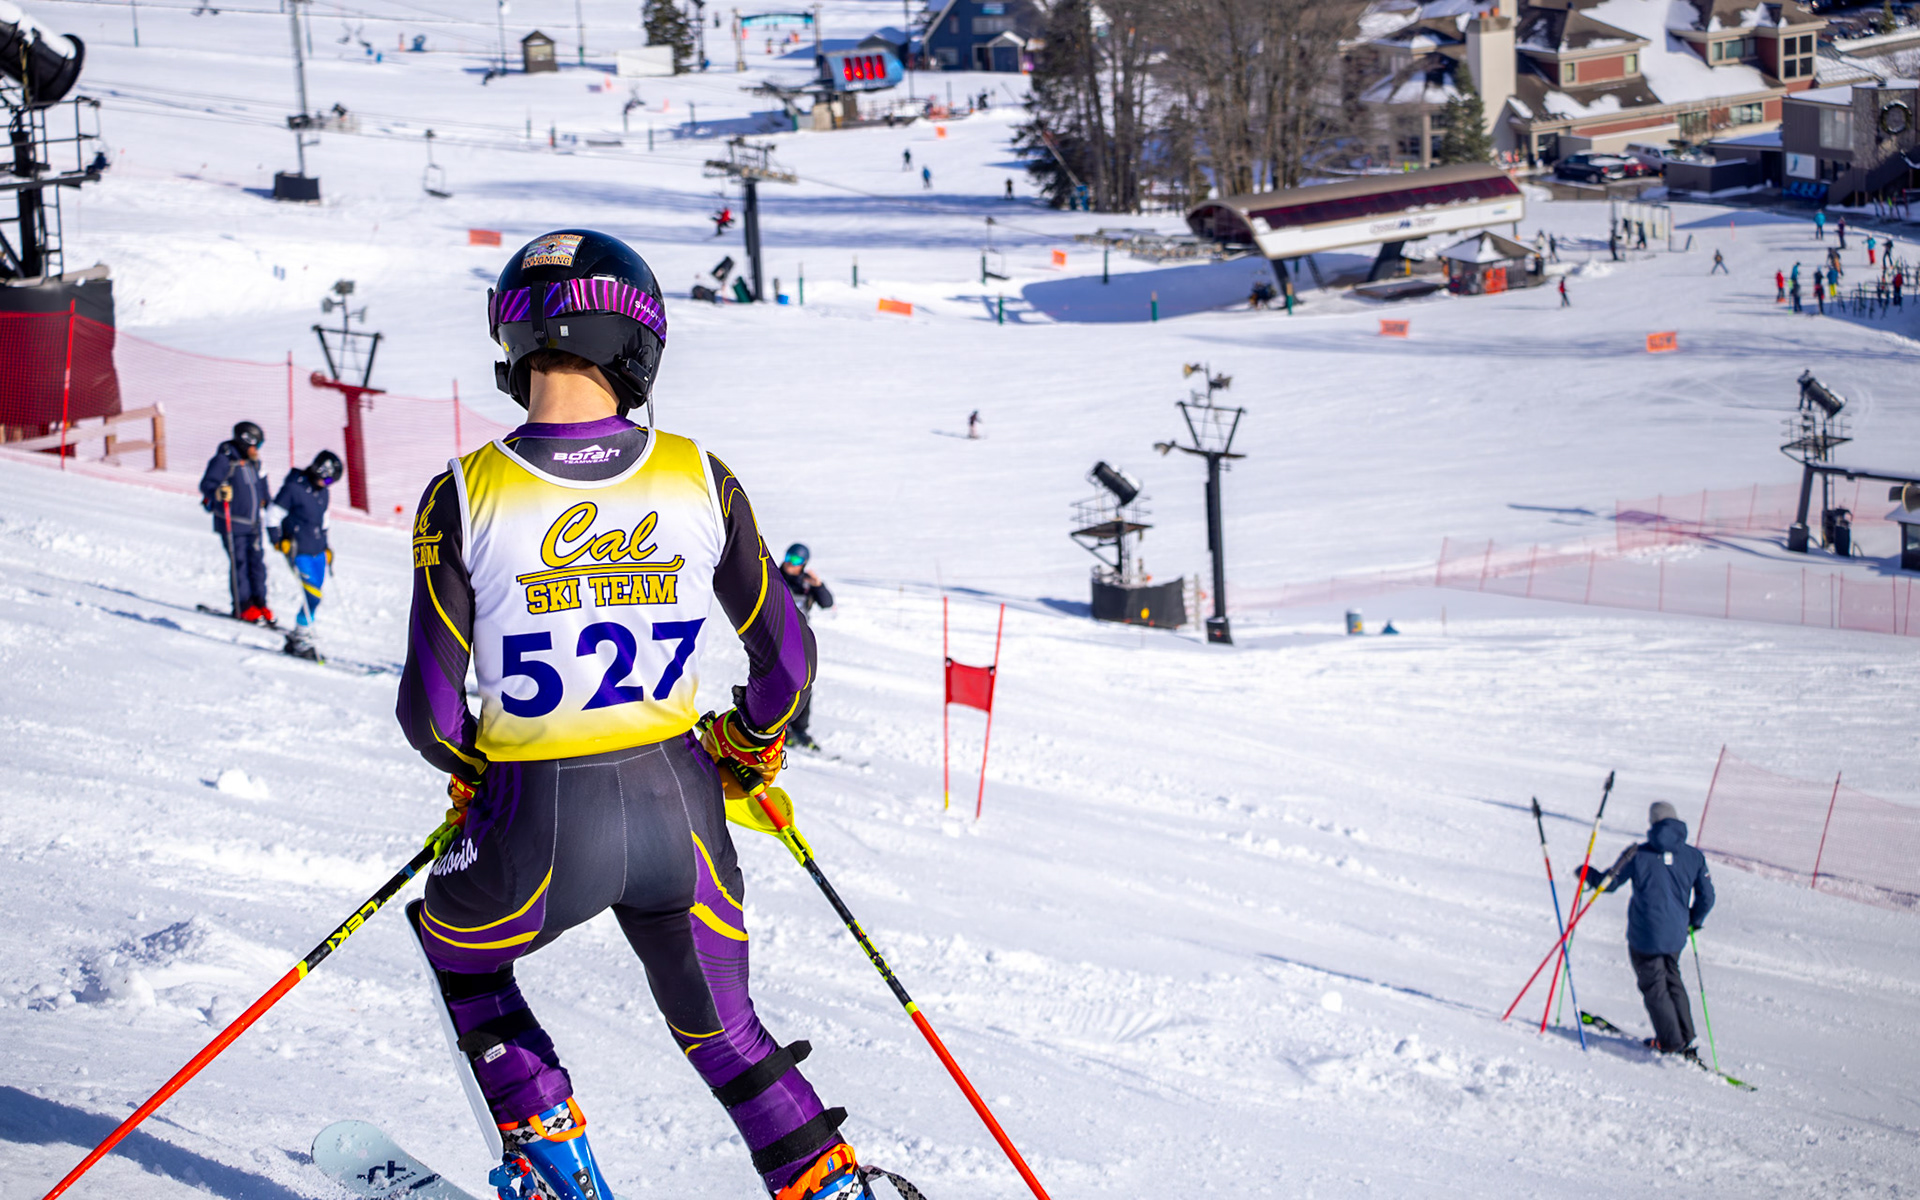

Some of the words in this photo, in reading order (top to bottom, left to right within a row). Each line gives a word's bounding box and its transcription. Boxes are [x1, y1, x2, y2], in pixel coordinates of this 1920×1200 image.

[524, 256, 571, 267] WYOMING
[413, 544, 441, 569] EAM
[541, 501, 658, 568] Cal
[526, 577, 582, 615] SKI
[588, 574, 678, 608] TEAM
[501, 617, 707, 718] 527
[326, 900, 379, 951] LEKI
